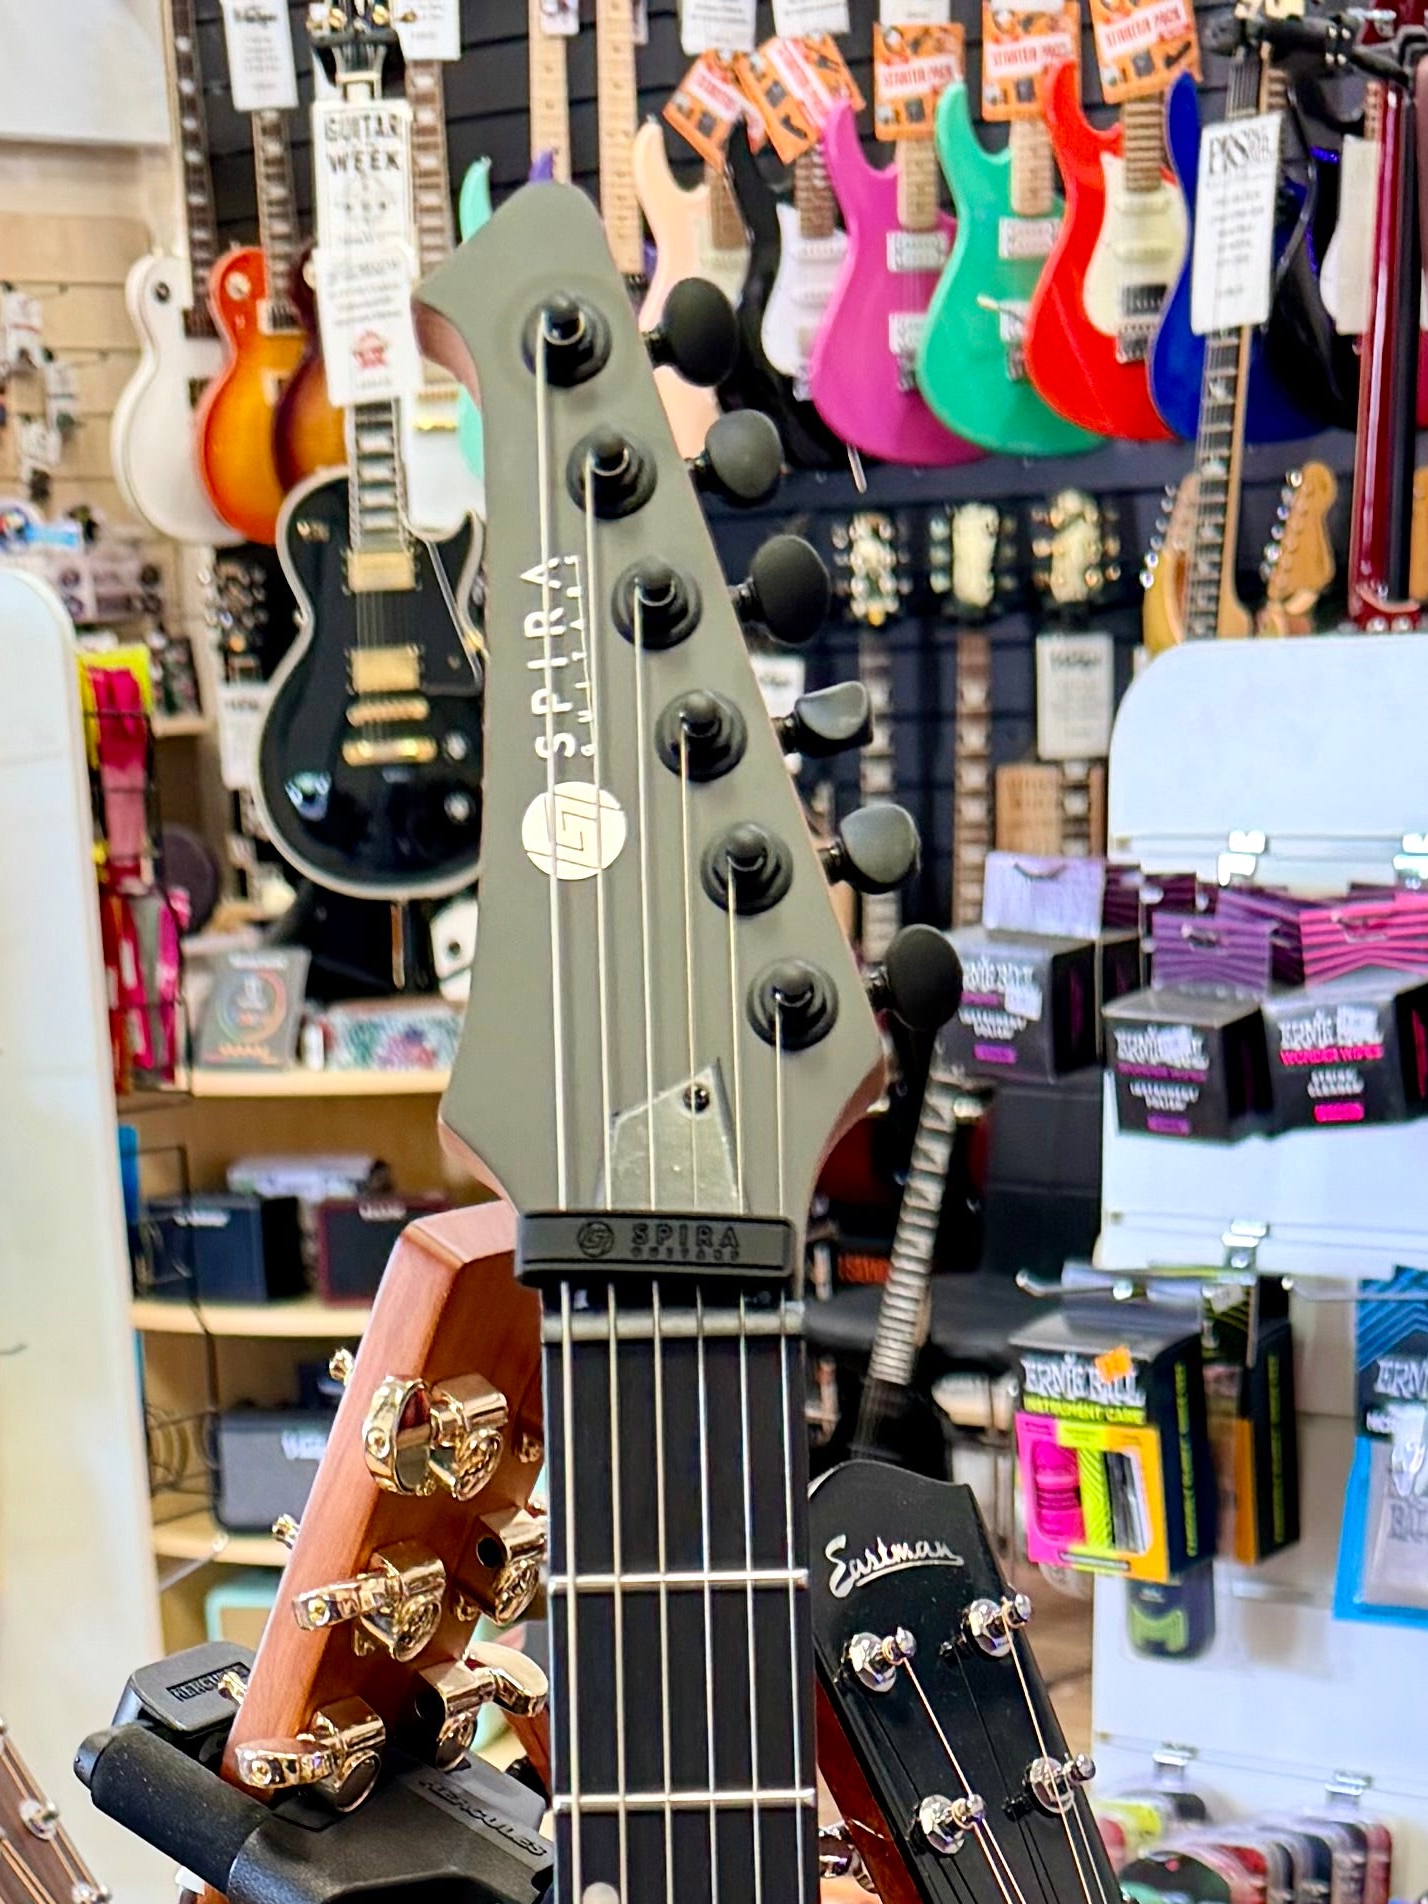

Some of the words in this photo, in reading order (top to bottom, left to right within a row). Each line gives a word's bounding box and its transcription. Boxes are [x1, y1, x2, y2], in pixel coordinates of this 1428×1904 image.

[328, 151, 401, 176] WEEK
[519, 556, 577, 759] SPIRA
[631, 1223, 740, 1250] SPIRA
[824, 1533, 966, 1600] Eastman
